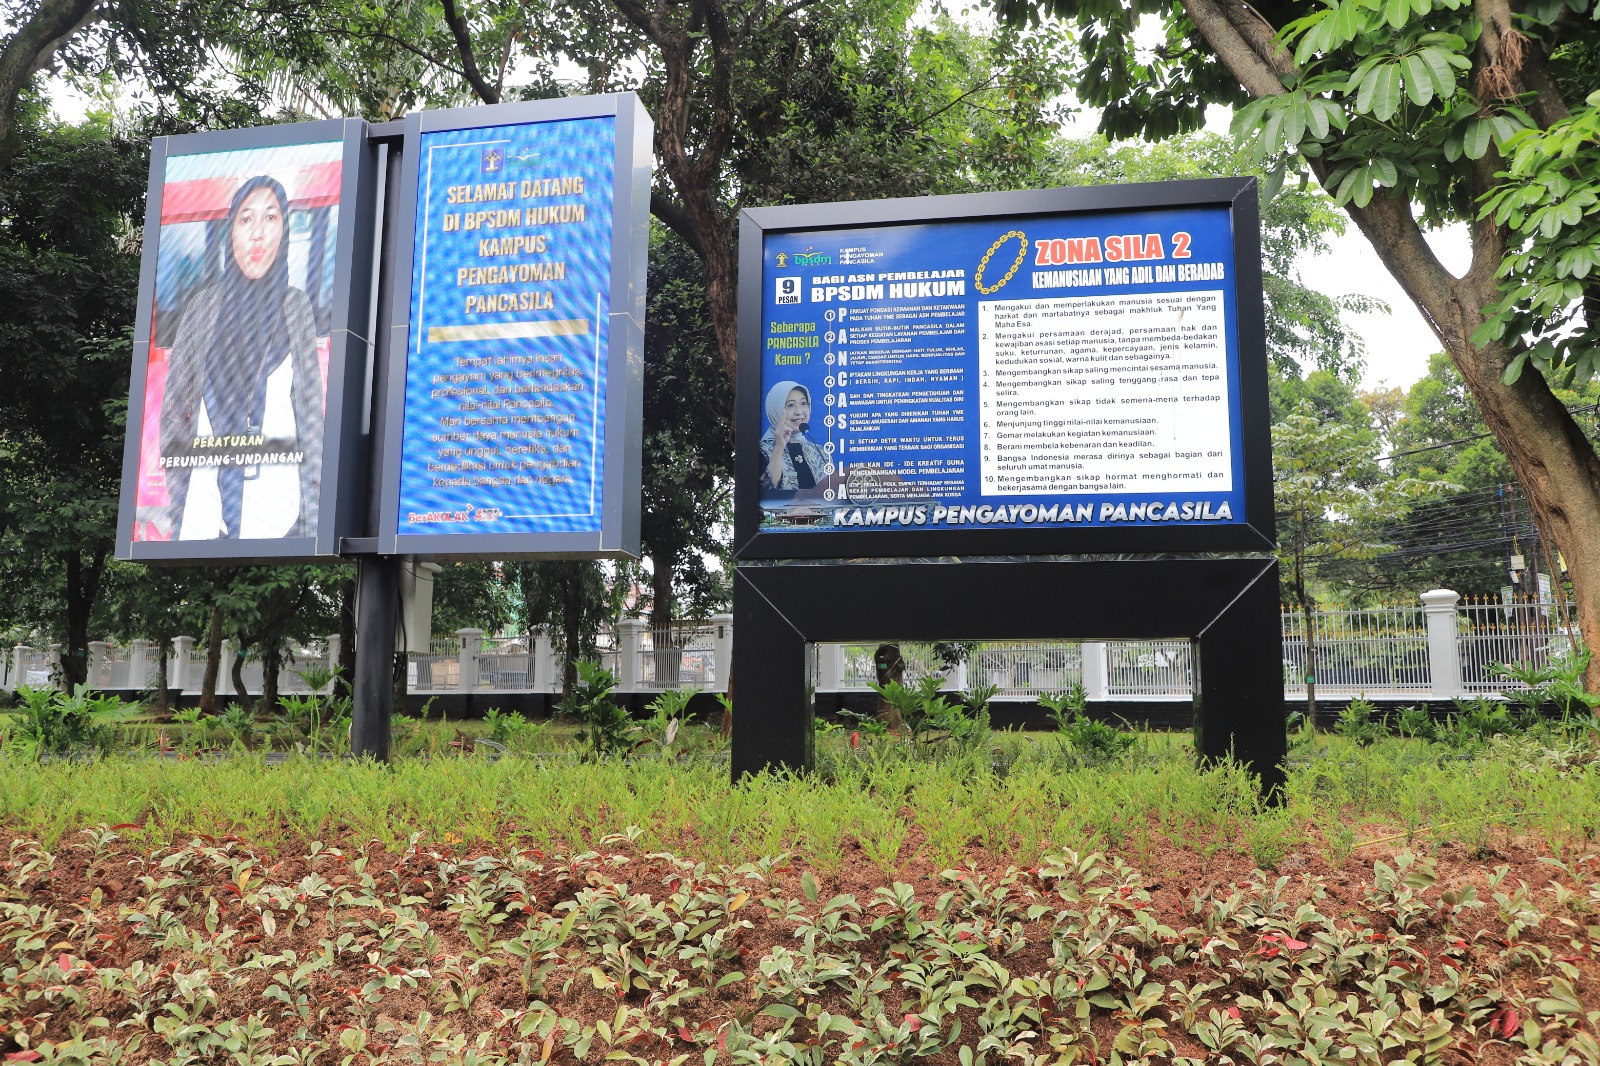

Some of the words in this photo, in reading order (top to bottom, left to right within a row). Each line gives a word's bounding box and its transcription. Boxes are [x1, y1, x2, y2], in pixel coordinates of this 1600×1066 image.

[446, 181, 517, 204] SELAMAT
[520, 175, 584, 198] DATANG
[443, 213, 460, 232] DI
[464, 208, 521, 230] BPSDM
[525, 203, 585, 225] HUKUM
[478, 234, 546, 257] KAMPUS
[1035, 236, 1103, 266] ZONA
[1104, 234, 1164, 262] SILA
[1172, 232, 1191, 259] 2
[794, 253, 831, 266] bpsdm
[456, 261, 565, 286] PENGAYOMAN
[812, 275, 844, 285] BAGI
[847, 274, 874, 283] ASN
[878, 269, 964, 281] PEMBELAJAR
[1032, 269, 1102, 289] KEMANUSIAAN
[1104, 268, 1129, 285] YANG
[1132, 267, 1154, 284] ADIL
[1155, 266, 1175, 282] DAN
[1178, 263, 1224, 281] BERADAB
[782, 279, 794, 294] 9
[811, 284, 883, 302] BPSDM
[889, 279, 965, 299] HUKUM
[465, 290, 554, 313] PANCASILA
[778, 295, 798, 303] PESAN
[994, 303, 1031, 312] Mengakui
[1053, 299, 1115, 309] memperlakukan
[1156, 296, 1182, 304] sesuai
[1185, 295, 1216, 304] dengan
[838, 307, 846, 322] P
[1041, 309, 1089, 319] martabatnya
[1093, 308, 1125, 316] sebagai
[1195, 304, 1216, 312] Yang
[770, 322, 816, 334] Seberapa
[994, 331, 1034, 340] Mengakui
[1039, 330, 1085, 338] persamaan
[1128, 326, 1175, 335] persamaan
[767, 336, 819, 349] PANCASILA
[838, 329, 847, 344] A
[995, 340, 1034, 349] kewajiban
[1056, 338, 1080, 347] setiap
[1118, 336, 1141, 344] tanpa
[1141, 333, 1217, 342] membeda-bedakan
[1159, 343, 1179, 352] jenis
[775, 353, 802, 365] Kamu
[804, 353, 811, 364] ?
[838, 350, 846, 365] N
[995, 357, 1037, 365] kedudukan
[1124, 352, 1171, 361] sebagainya.
[995, 367, 1061, 377] Mengembangkan
[1062, 367, 1083, 375] sikap
[1084, 366, 1108, 374] saling
[1109, 364, 1149, 372] mencintai
[837, 371, 846, 386] C
[995, 379, 1061, 389] Mengembangkan
[1065, 378, 1087, 386] sikap
[1090, 377, 1115, 386] saling
[1118, 376, 1156, 385] tenggang
[1201, 374, 1219, 382] tepa
[837, 392, 847, 407] A
[996, 399, 1064, 408] Mengembangkan
[1069, 398, 1091, 406] sikap
[1182, 394, 1220, 403] terhadap
[838, 413, 846, 429] S
[996, 420, 1042, 428] Menjunjung
[1042, 419, 1066, 427] tinggi
[1103, 416, 1158, 424] kemanusiaan.
[1023, 430, 1065, 438] melakukan
[1066, 430, 1101, 438] kegiatan
[1101, 428, 1156, 436] kemanusiaan.
[193, 435, 263, 448] PERATURAN
[839, 438, 844, 453] I
[159, 452, 303, 468] PERUNDANG-UNDANGAN
[997, 454, 1027, 463] Bangsa
[1106, 452, 1135, 460] dirinya
[1138, 451, 1170, 460] sebagai
[1174, 450, 1203, 459] bagian
[838, 461, 845, 476] L
[997, 474, 1071, 483] Mengembangkan
[1076, 474, 1100, 482] sikap
[1141, 472, 1202, 481] menghormati
[837, 483, 846, 499] A
[997, 484, 1047, 493] bekerjasama
[1048, 483, 1078, 492] dengan
[1079, 483, 1108, 491] bangsa
[833, 508, 926, 526] KAMPUS
[931, 503, 1092, 525] PENGAYOMAN
[1098, 501, 1232, 522] PANCASILA
